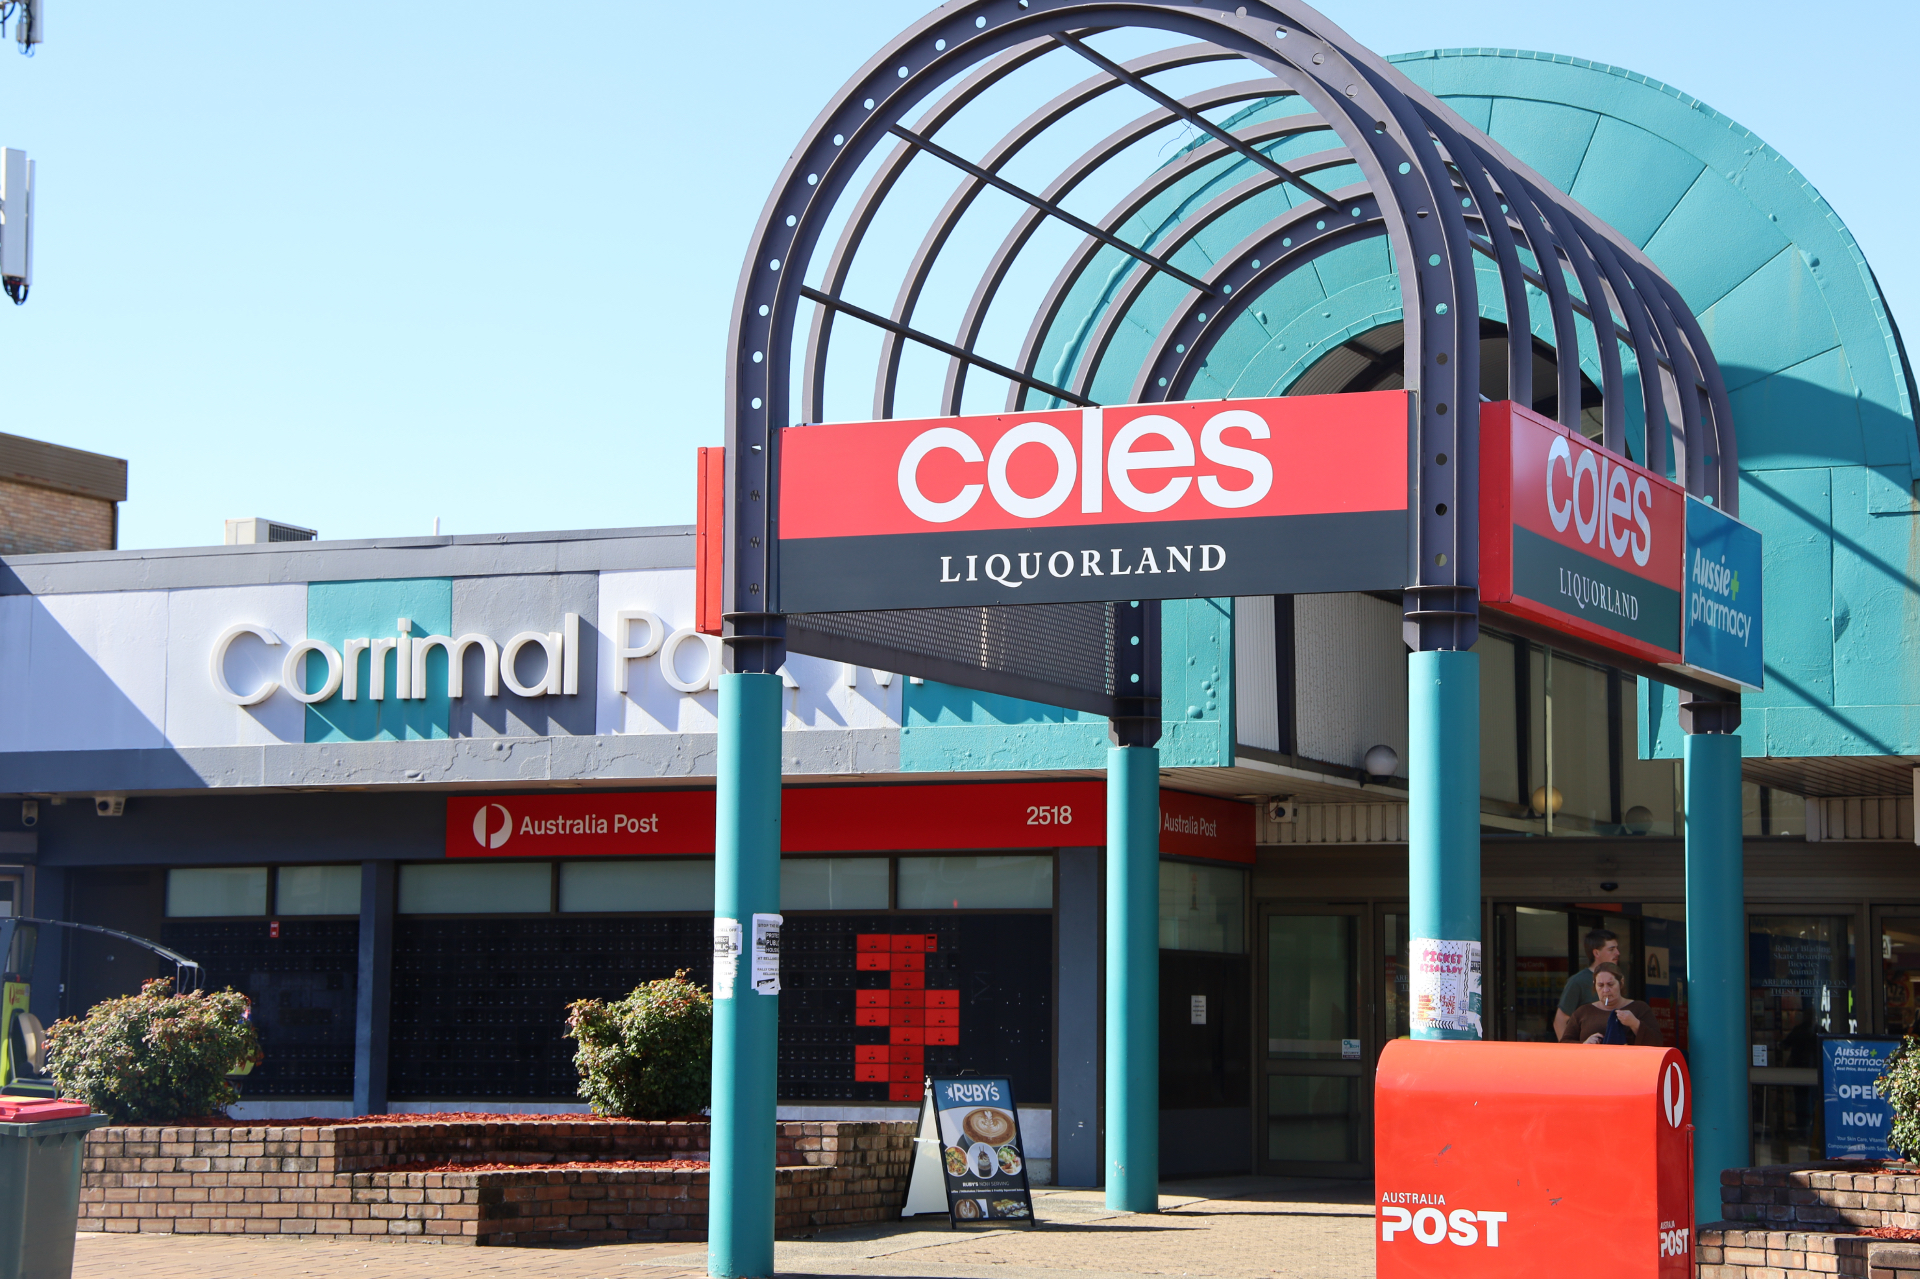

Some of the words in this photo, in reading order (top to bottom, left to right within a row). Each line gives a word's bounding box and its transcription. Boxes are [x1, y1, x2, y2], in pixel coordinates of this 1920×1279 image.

[898, 408, 1273, 523] coles
[1546, 435, 1652, 567] coles
[940, 544, 1227, 588] LIQUORLAND
[1692, 548, 1731, 596] Aussie
[1559, 567, 1638, 621] LIQUORLAND
[1691, 589, 1751, 648] pharmacy
[209, 613, 579, 706] Corrimal
[519, 814, 608, 835] Australia
[614, 813, 659, 834] Post
[1026, 805, 1072, 825] 2518
[1164, 812, 1198, 835] Australia
[1199, 817, 1217, 837] Post
[1423, 950, 1463, 964] PICKET
[1797, 953, 1833, 961] Boarding
[1801, 945, 1831, 954] Blading
[1788, 960, 1819, 969] Bicycles
[1442, 1001, 1455, 1009] JUNE
[1834, 1046, 1869, 1057] Aussie
[1842, 1112, 1883, 1127] NOW
[1382, 1191, 1446, 1206] AUSTRALIA
[1382, 1206, 1507, 1247] POST
[1660, 1227, 1689, 1258] POST
